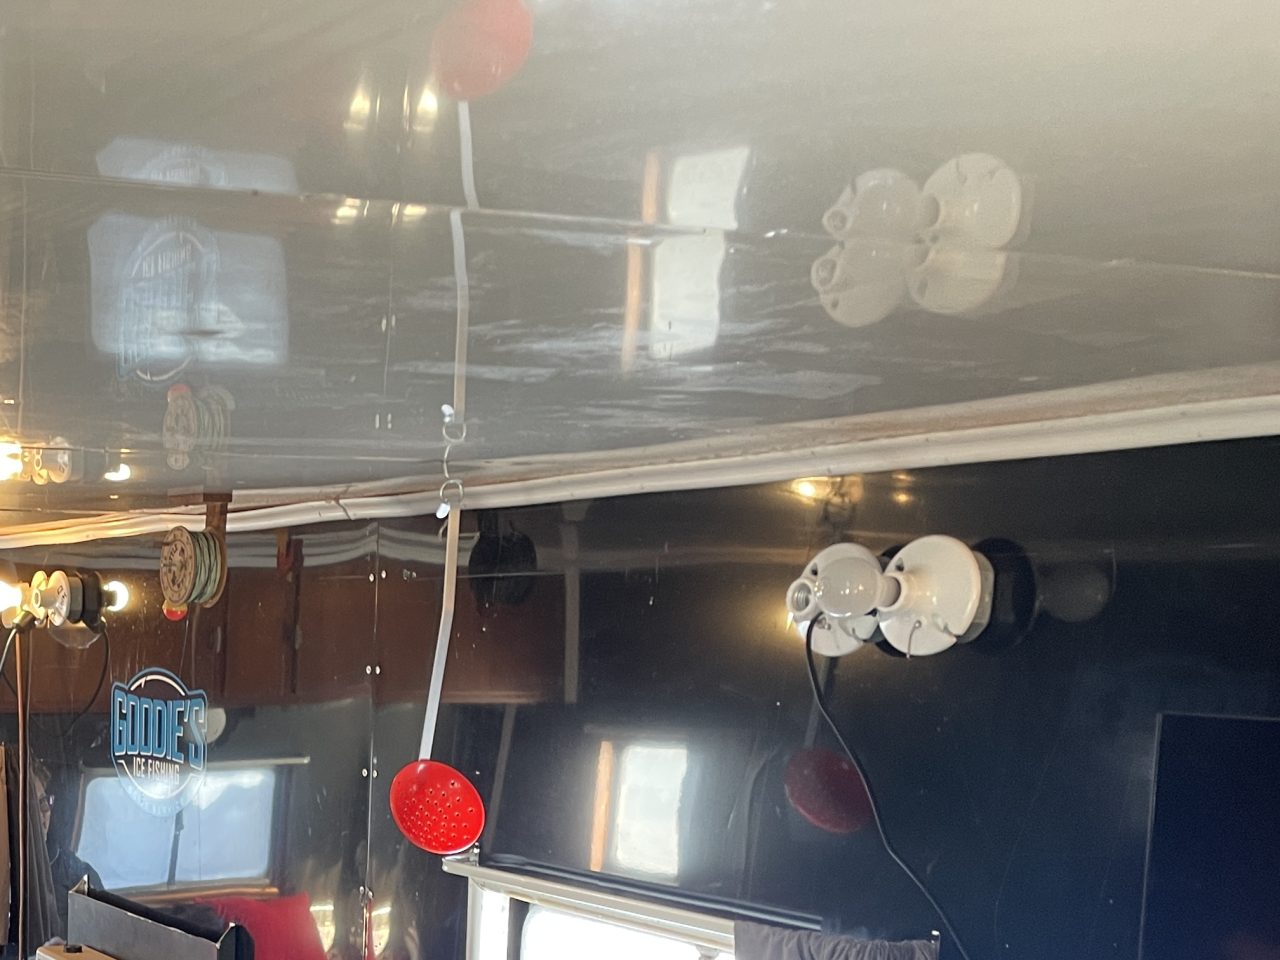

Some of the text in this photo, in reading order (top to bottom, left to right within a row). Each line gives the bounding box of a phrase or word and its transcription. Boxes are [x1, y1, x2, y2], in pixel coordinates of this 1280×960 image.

[114, 689, 204, 770] GOODIE'S
[133, 757, 180, 784] ICE FISHING
